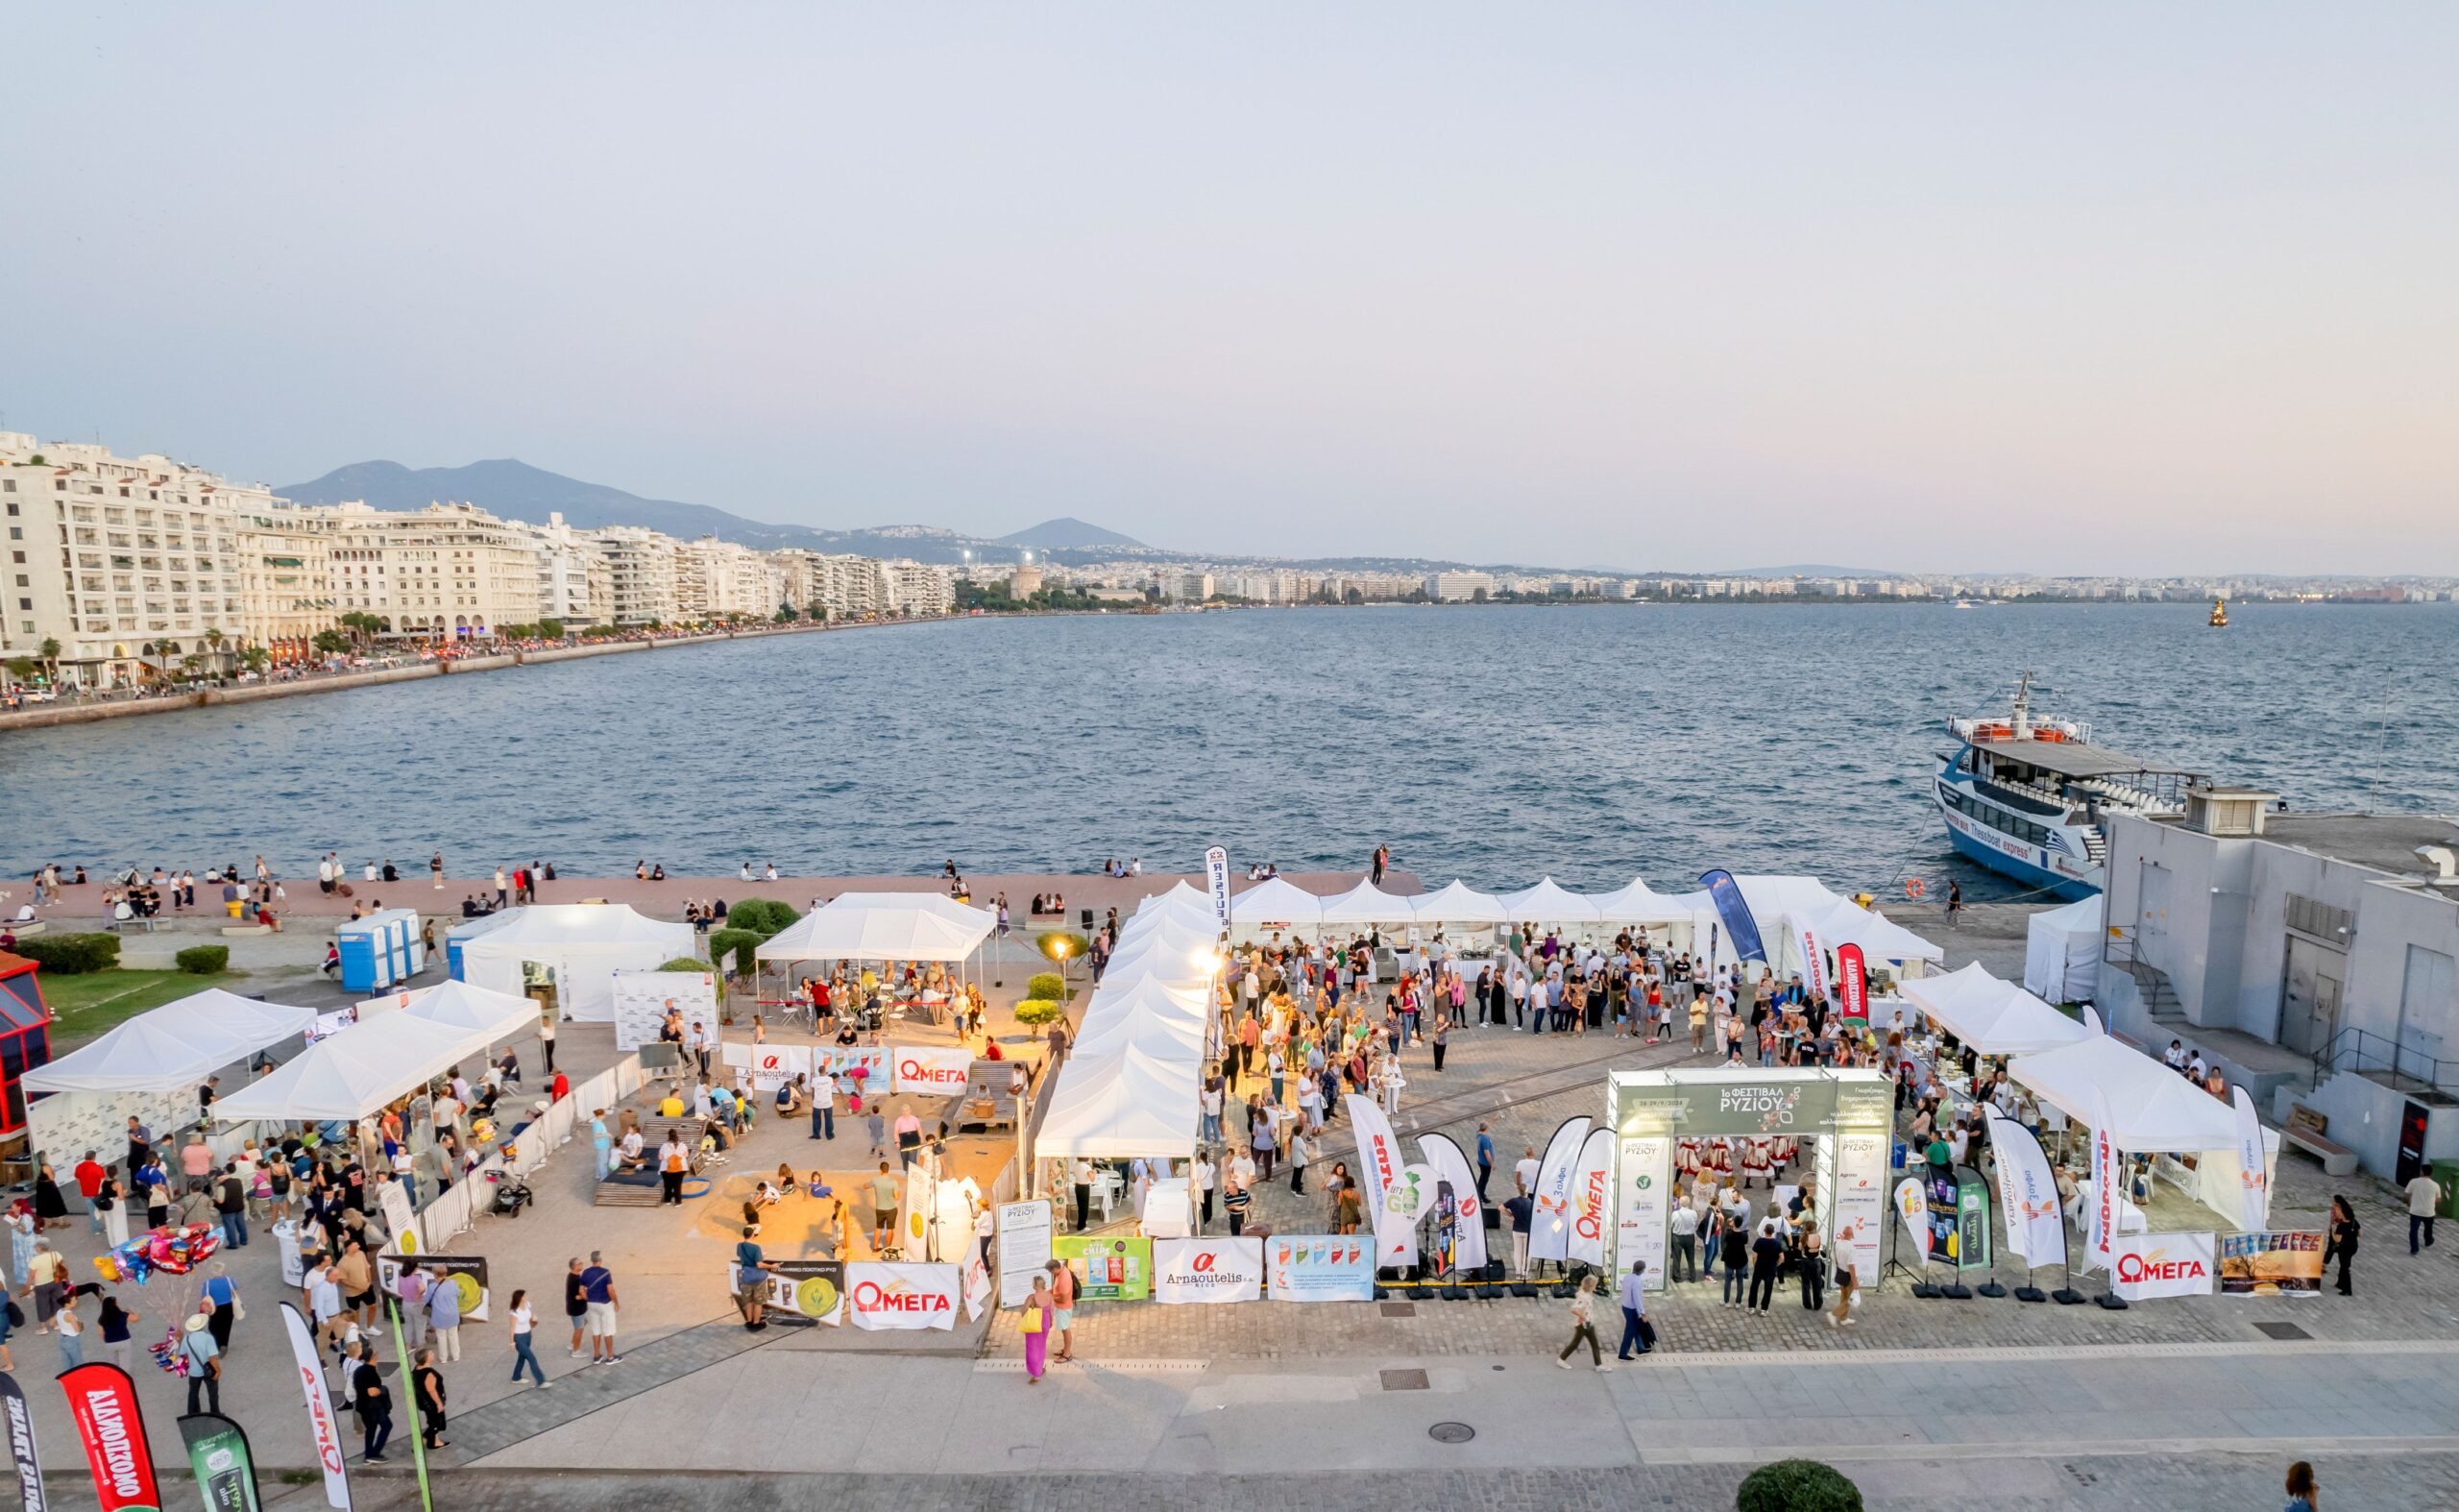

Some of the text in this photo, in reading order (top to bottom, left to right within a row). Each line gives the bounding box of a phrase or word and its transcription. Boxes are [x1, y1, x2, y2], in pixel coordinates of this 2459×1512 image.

[1971, 822, 2001, 848] Thessboat
[2003, 841, 2029, 860] express
[900, 1060, 966, 1083] ΩΜΕΓΑ
[1732, 1087, 1784, 1097] ΦΕΣΤΙΒΑΛ
[1576, 1170, 1606, 1241] ΩΜΕΓΑ
[1166, 1273, 1242, 1283] Arnaoutelis
[2118, 1253, 2205, 1283] ΩΜΕΓΑ
[854, 1280, 950, 1312] ΩΜΕΓΑ
